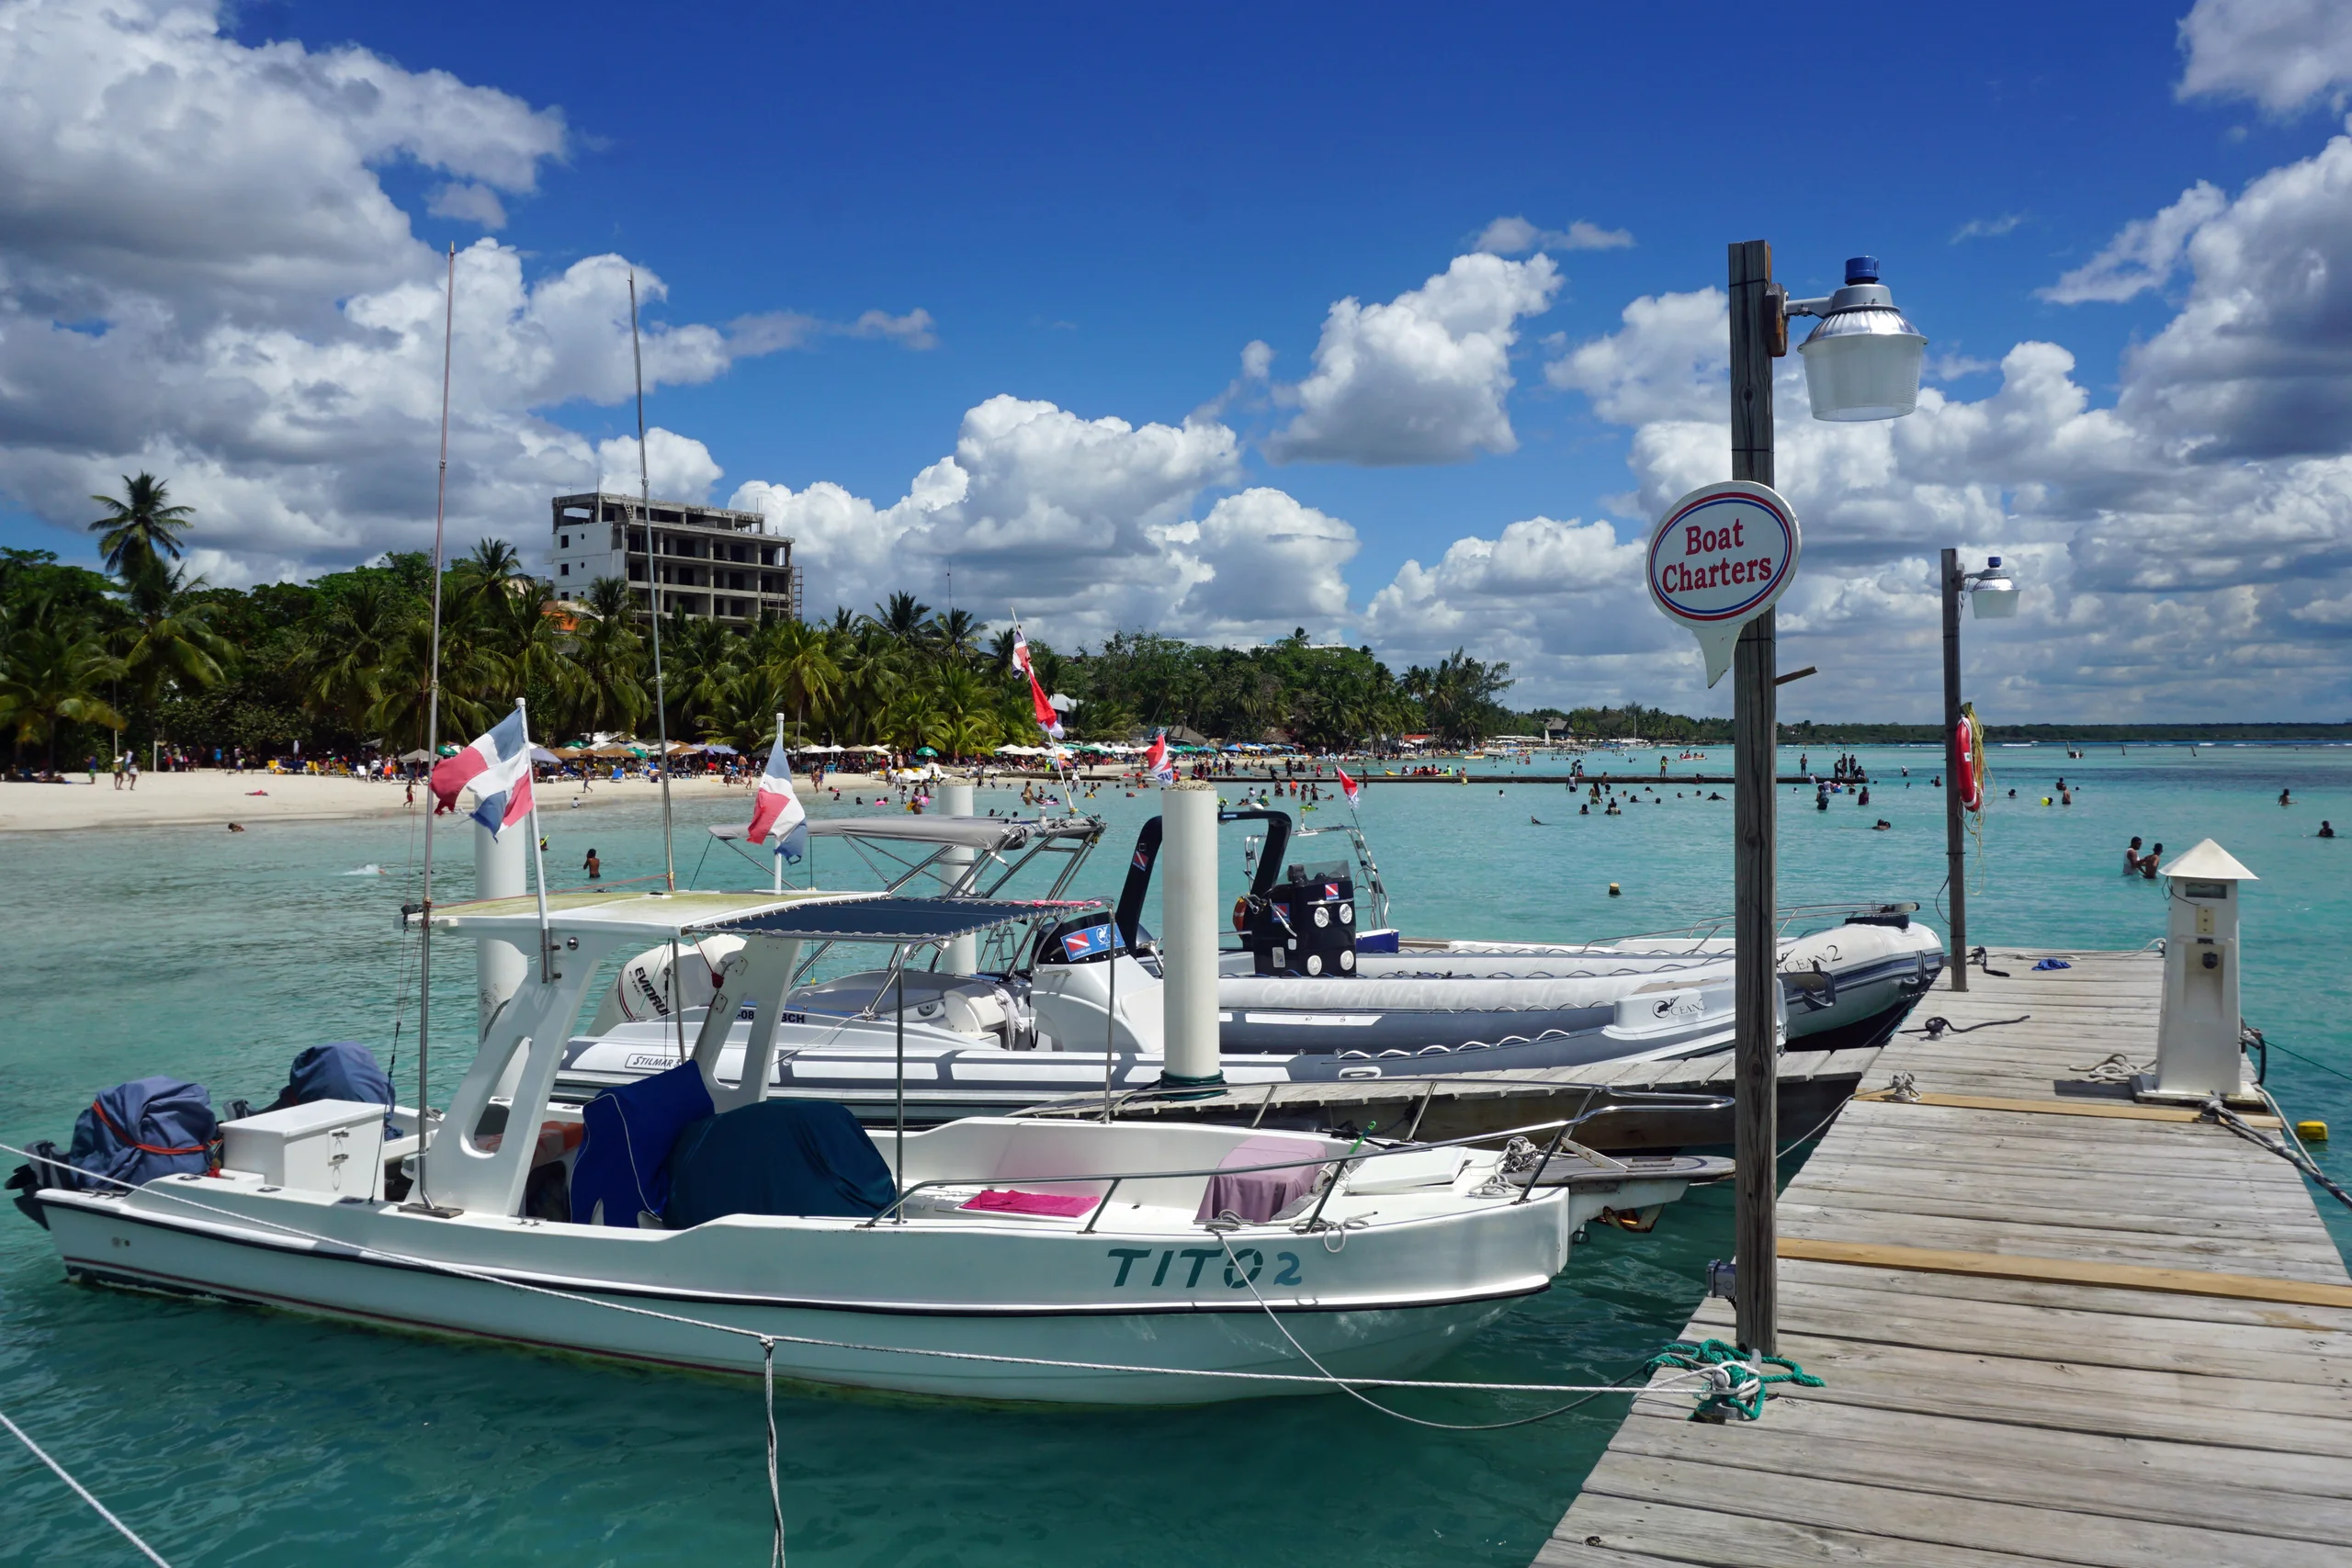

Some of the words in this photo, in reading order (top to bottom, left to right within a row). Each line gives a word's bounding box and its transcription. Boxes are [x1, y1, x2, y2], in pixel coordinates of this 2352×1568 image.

[1685, 518, 1744, 556] Boat
[1662, 558, 1772, 593] Charters
[635, 966, 671, 1016] EVINRU
[633, 1056, 673, 1066] STILMAR
[1107, 1247, 1263, 1289] TITO
[1273, 1251, 1303, 1286] 2
